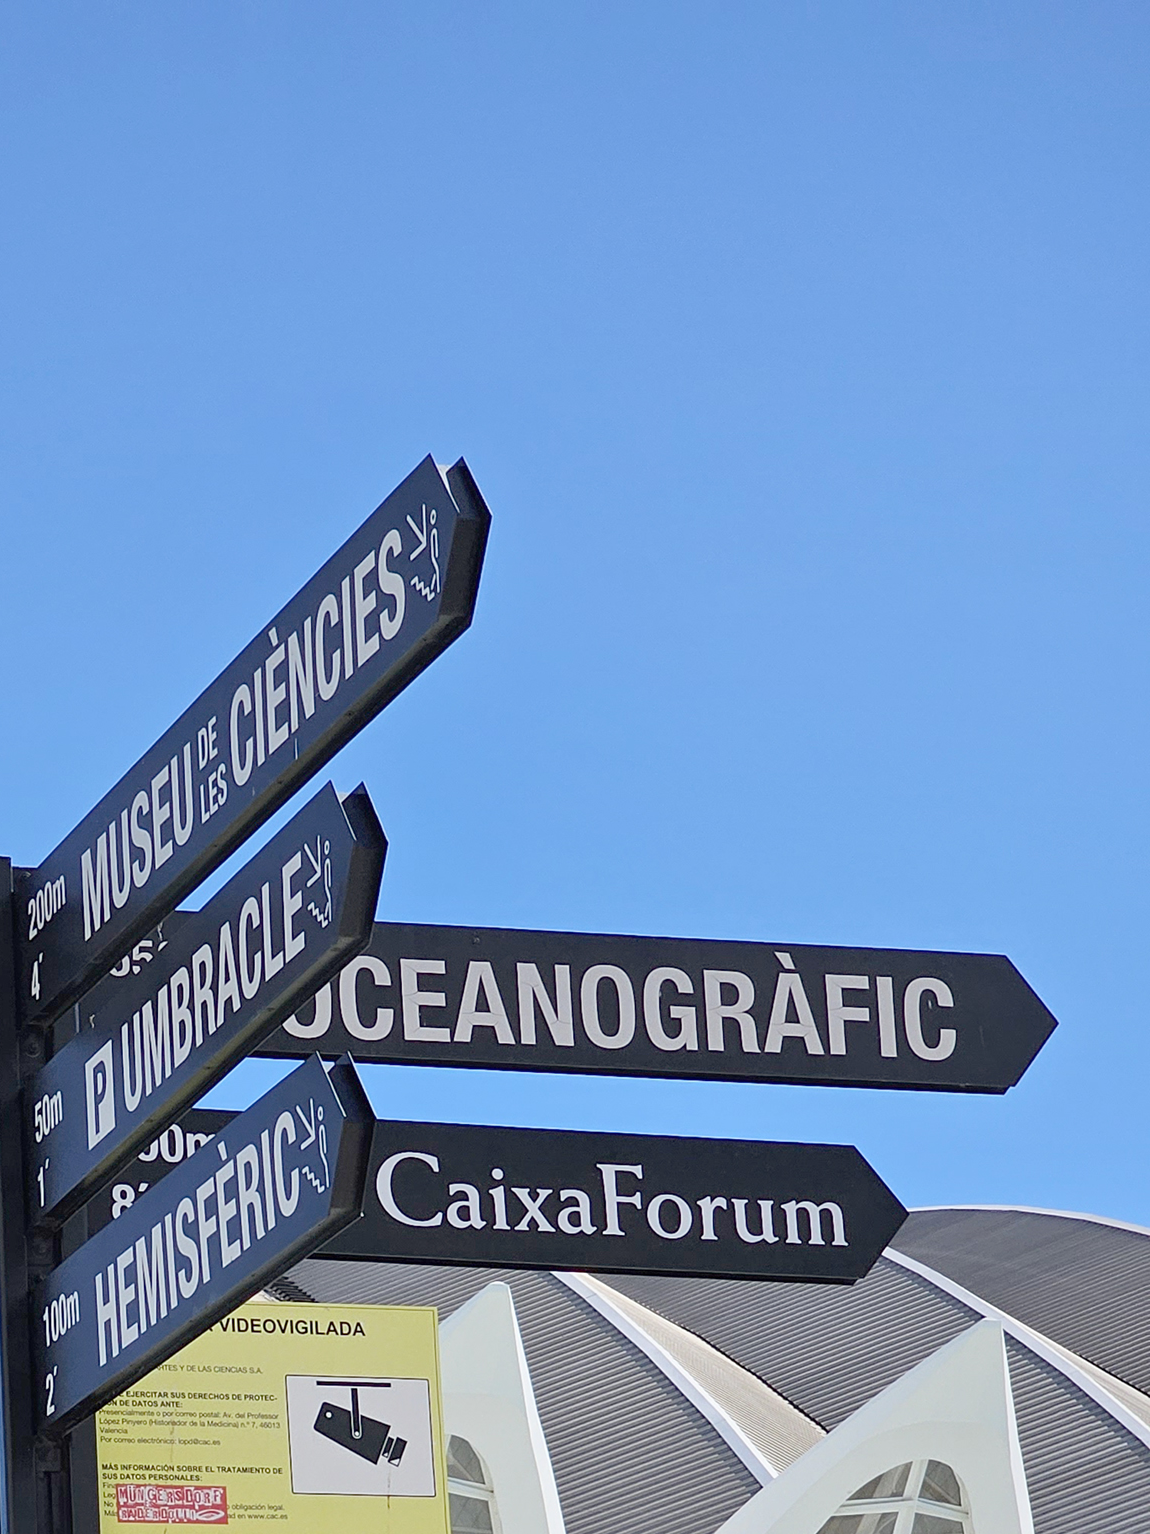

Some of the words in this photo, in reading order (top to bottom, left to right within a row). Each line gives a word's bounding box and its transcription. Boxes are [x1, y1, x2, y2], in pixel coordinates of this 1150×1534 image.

[228, 528, 406, 787] CIÈNCIES
[197, 716, 219, 770] DE
[200, 762, 228, 824] LES
[80, 741, 194, 942] MUSEU
[28, 874, 67, 941] 200m
[121, 851, 305, 1112] UMBRACLE
[34, 1090, 63, 1143] 50m
[376, 1150, 848, 1245] CaixaForum
[94, 1110, 301, 1367] HEMISFÈRIC
[43, 1291, 80, 1347] 100m
[219, 1317, 365, 1336] VIDEOVIGILADA
[125, 1390, 169, 1398] EJERCITAR
[188, 1392, 230, 1400] DERECHOS
[213, 1366, 247, 1374] CIENCIAS
[122, 1418, 147, 1426] Pinyero
[120, 1464, 174, 1472] INFORMACIÓN
[217, 1466, 271, 1474] TRATAMIENTO
